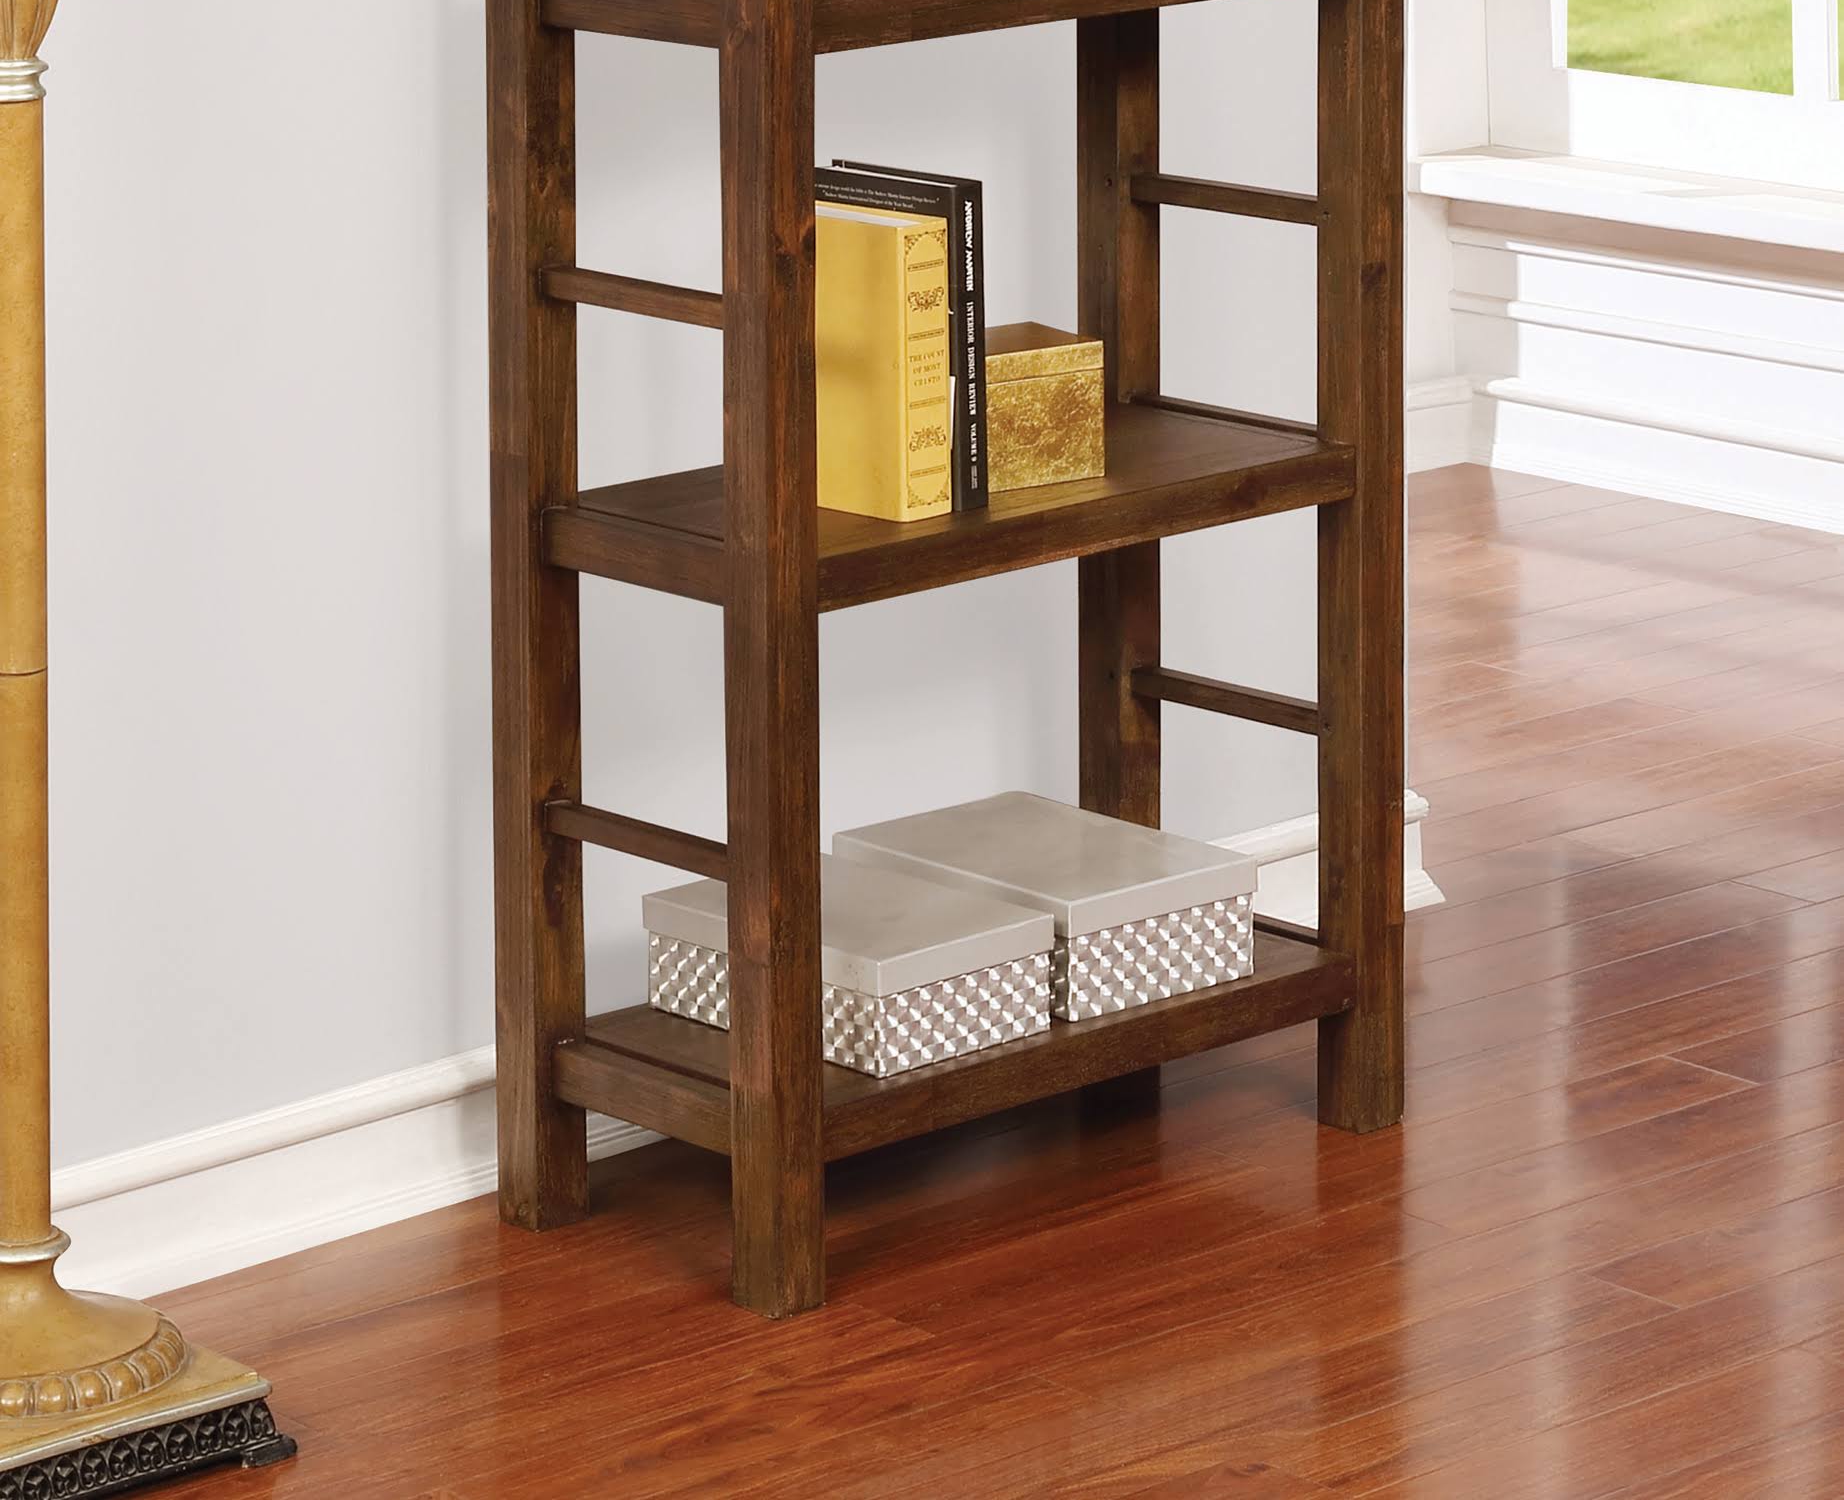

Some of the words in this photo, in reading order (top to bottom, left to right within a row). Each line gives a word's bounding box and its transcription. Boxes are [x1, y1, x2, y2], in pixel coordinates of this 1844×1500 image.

[964, 200, 973, 249] ANDREW
[965, 249, 974, 292] MARTIN
[966, 301, 976, 344] INTERIOR
[967, 346, 976, 380] DESIGN
[968, 382, 977, 416] REVIEW
